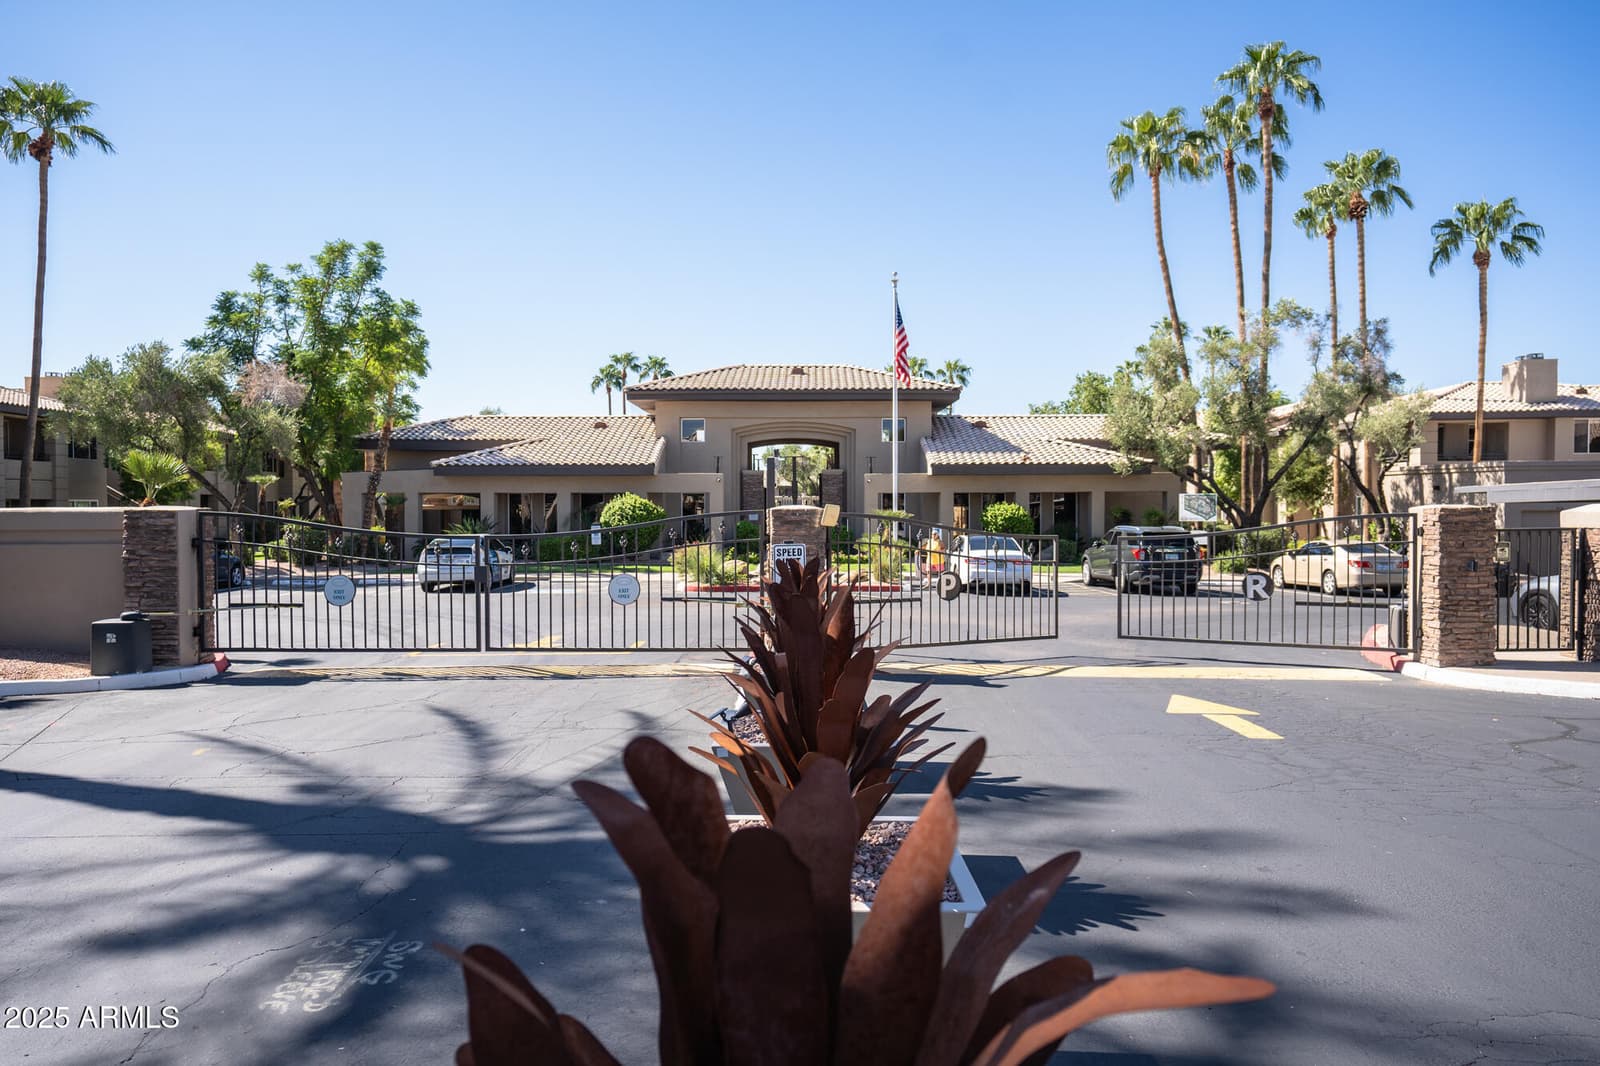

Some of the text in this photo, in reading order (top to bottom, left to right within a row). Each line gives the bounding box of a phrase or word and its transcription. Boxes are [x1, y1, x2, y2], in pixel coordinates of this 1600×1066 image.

[776, 548, 802, 557] SPEED
[941, 574, 957, 599] P
[1246, 574, 1269, 599] R
